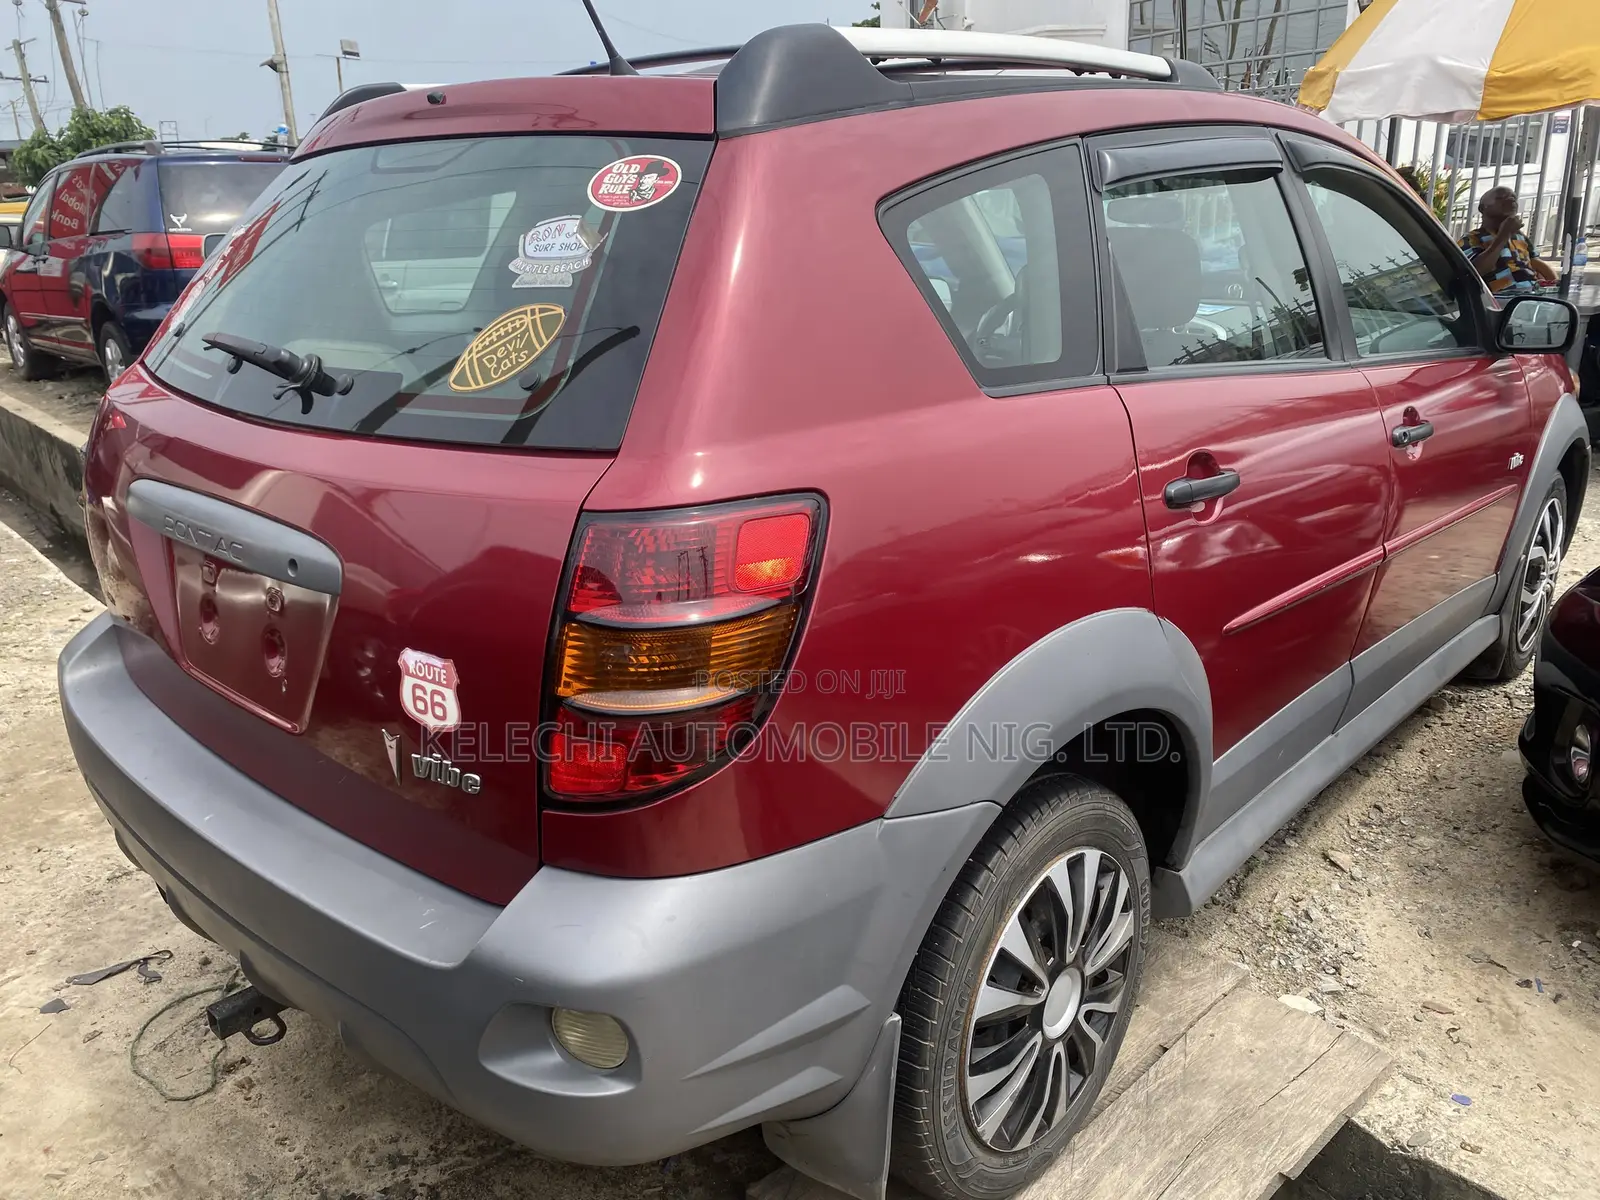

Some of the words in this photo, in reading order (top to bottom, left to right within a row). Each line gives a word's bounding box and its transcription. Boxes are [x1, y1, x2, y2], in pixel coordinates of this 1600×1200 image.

[602, 173, 638, 184] GUYS
[612, 163, 641, 174] OLD
[598, 184, 633, 194] RULE
[528, 223, 567, 246] RON
[533, 243, 557, 253] SURF
[558, 242, 584, 252] SHOP
[513, 259, 551, 274] MYRTLE
[553, 260, 590, 273] BEACH
[482, 332, 530, 368] Devil
[490, 350, 529, 378] Cats
[163, 515, 244, 563] PONTIAC
[408, 660, 448, 684] ROUTE
[411, 683, 448, 721] 66
[942, 967, 977, 1141] ASSURANCE
